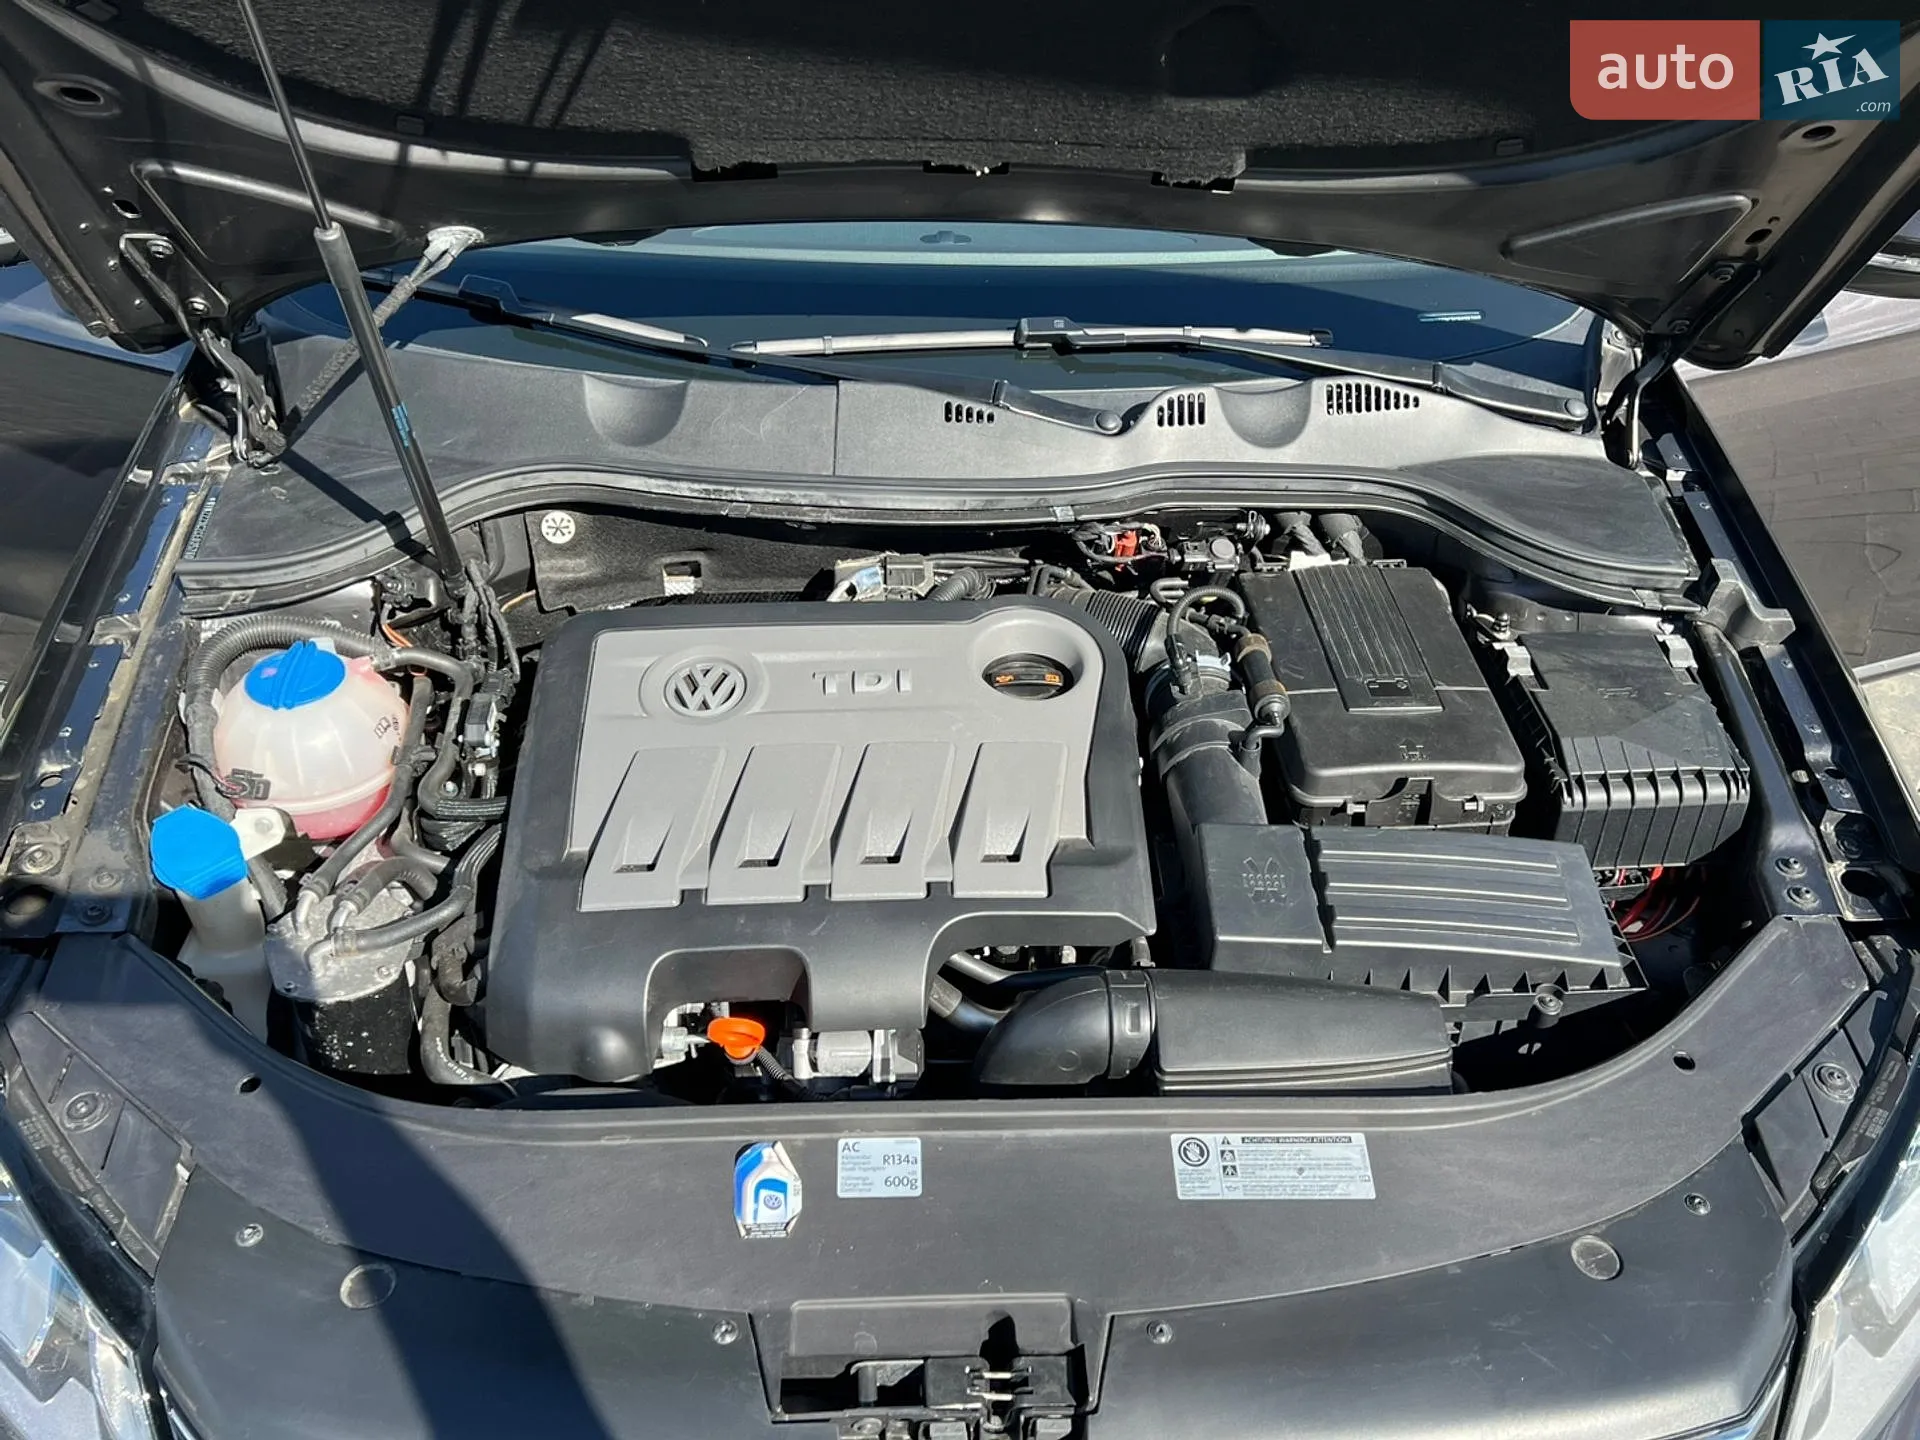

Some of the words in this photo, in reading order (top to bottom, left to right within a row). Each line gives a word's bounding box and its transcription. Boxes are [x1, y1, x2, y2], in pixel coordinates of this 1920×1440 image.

[811, 668, 912, 696] TDI
[842, 1141, 861, 1153] AC
[882, 1154, 918, 1166] R134a
[884, 1176, 918, 1190] 600g
